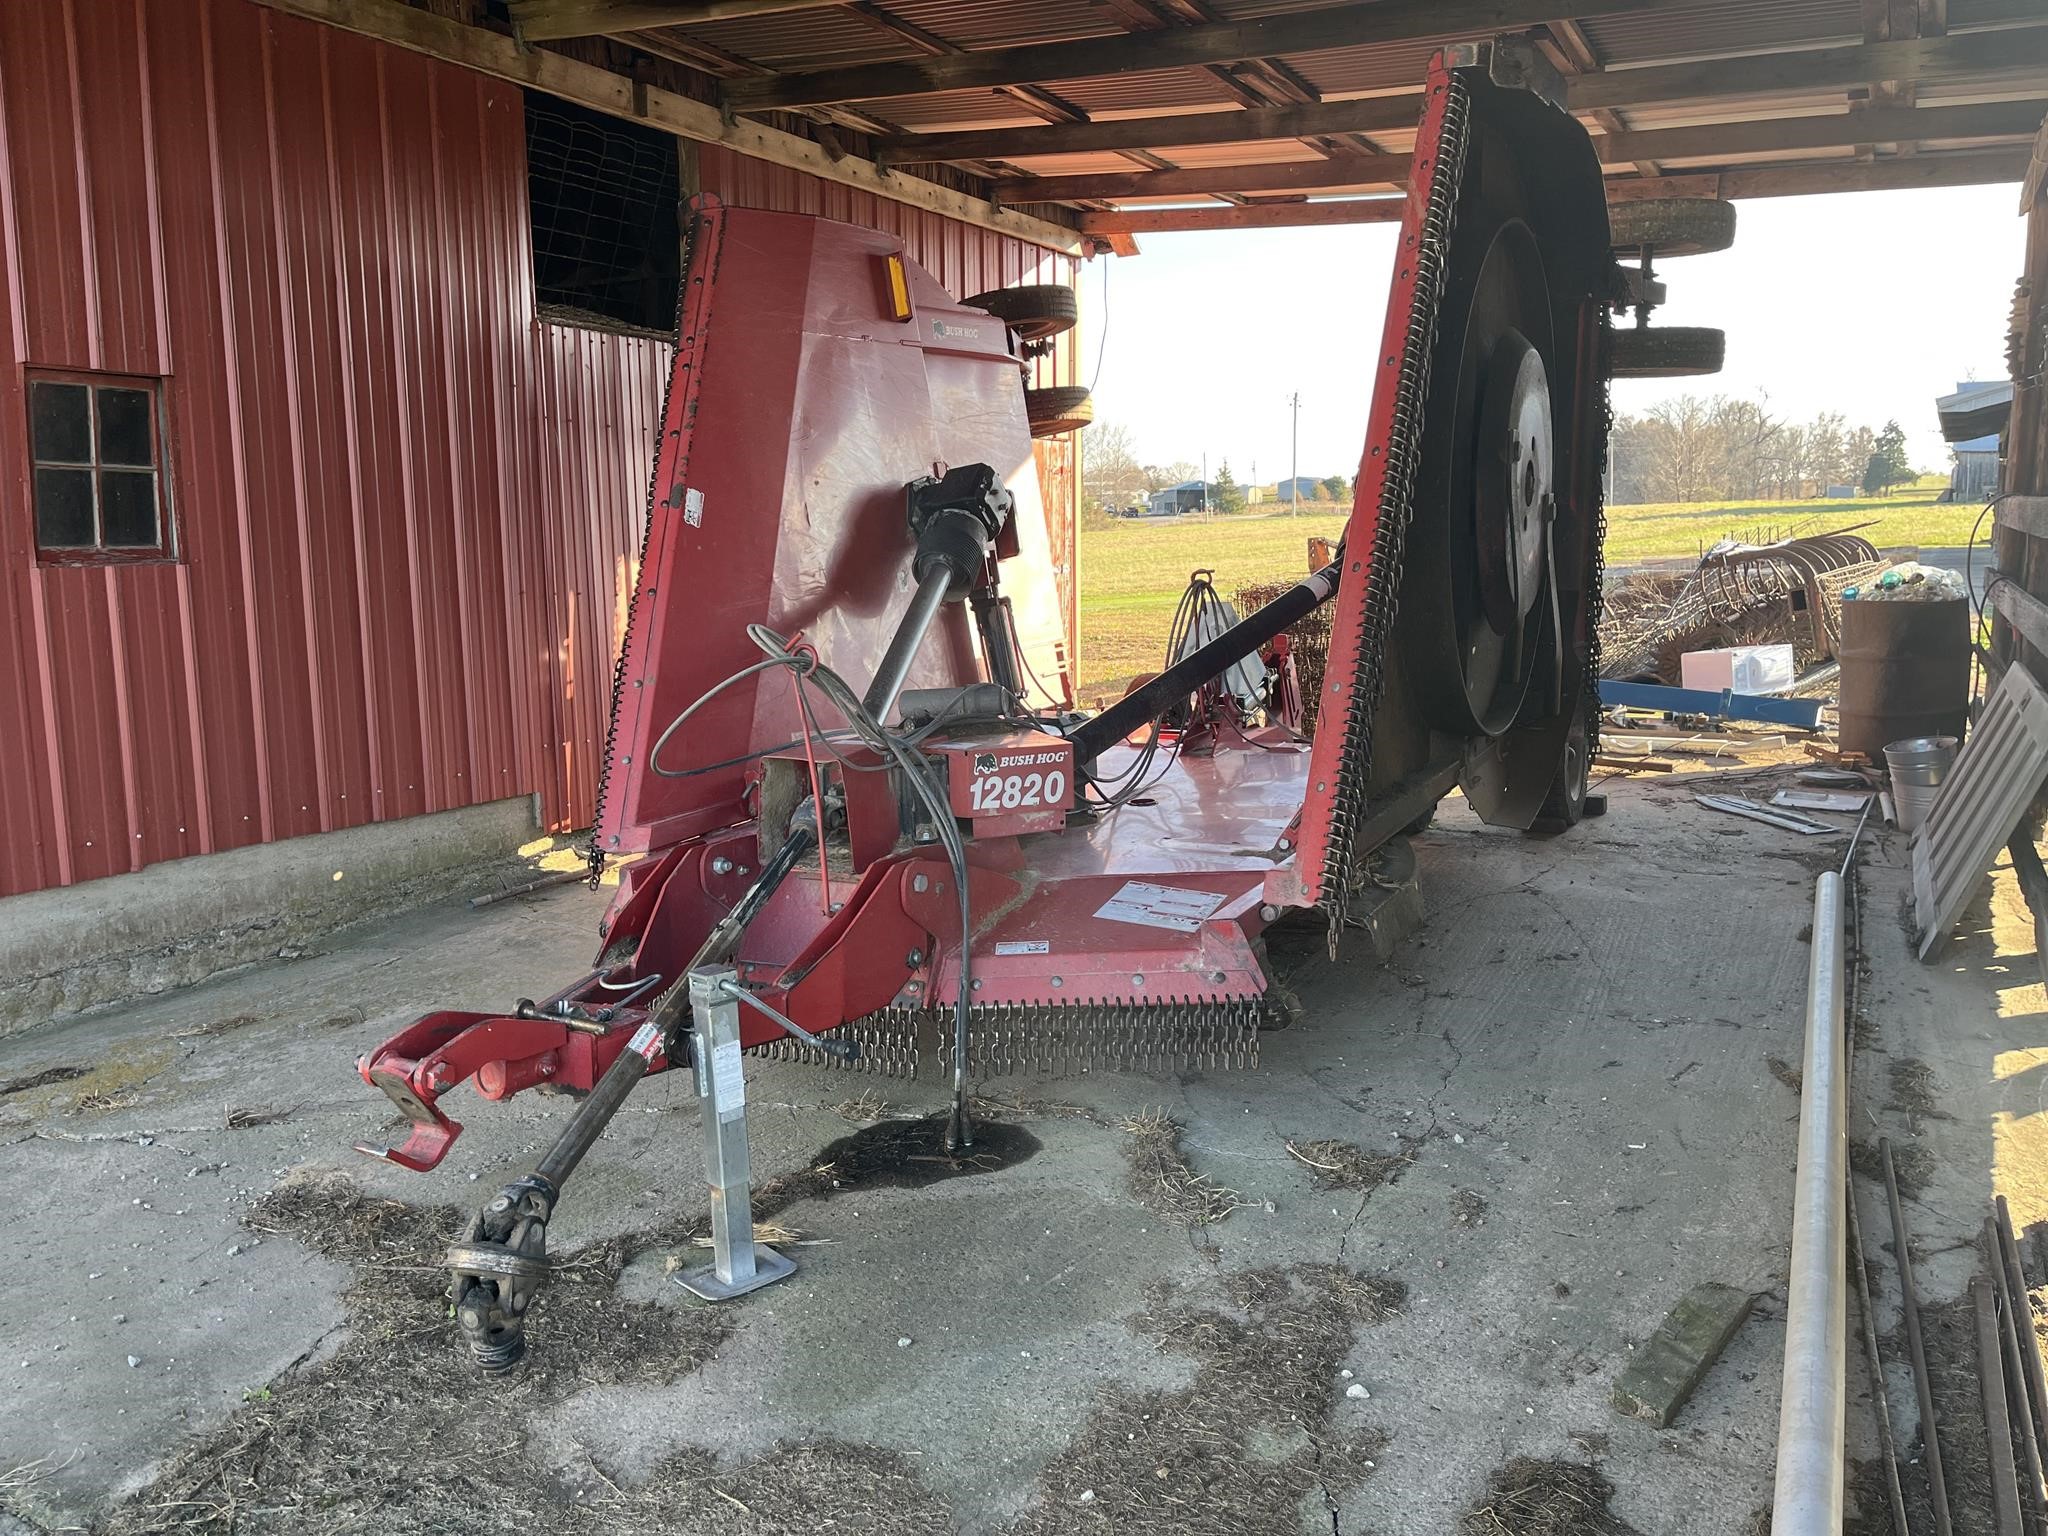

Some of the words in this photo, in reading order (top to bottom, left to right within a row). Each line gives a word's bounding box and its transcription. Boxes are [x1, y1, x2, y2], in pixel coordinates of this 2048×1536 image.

[945, 326, 963, 337] BUSH
[1000, 754, 1035, 768] BUSH
[970, 770, 1065, 811] 12820
